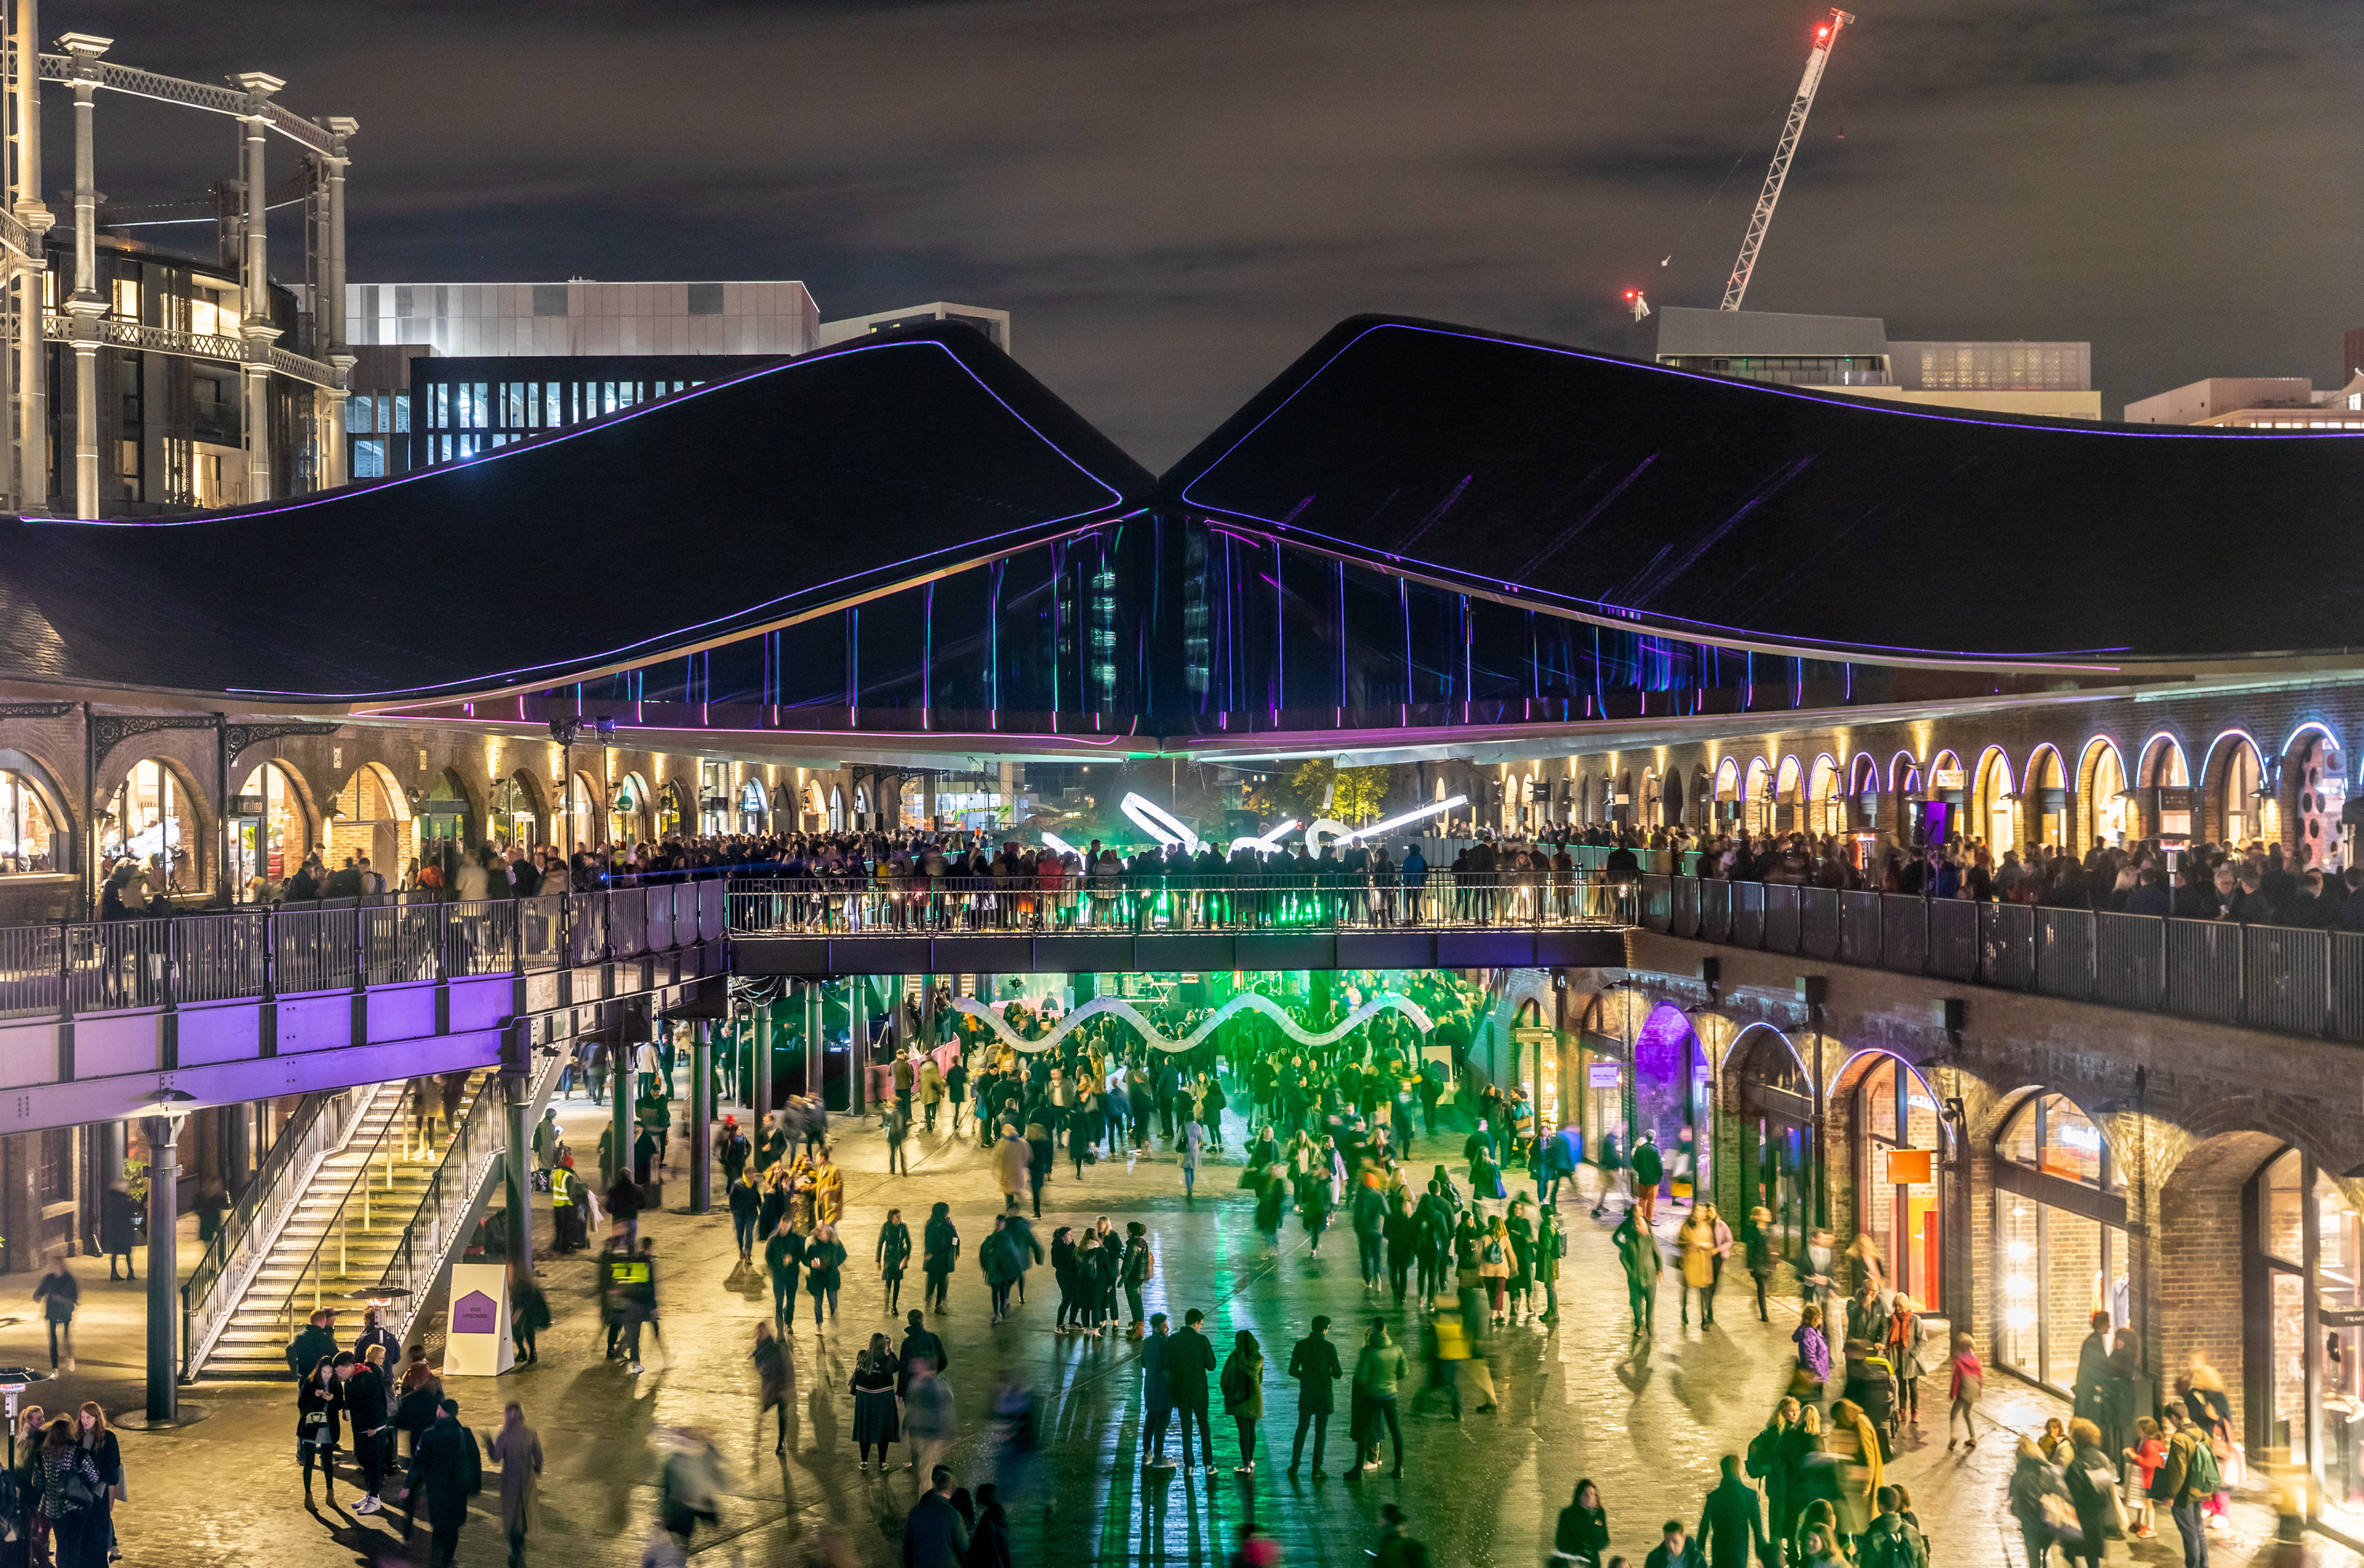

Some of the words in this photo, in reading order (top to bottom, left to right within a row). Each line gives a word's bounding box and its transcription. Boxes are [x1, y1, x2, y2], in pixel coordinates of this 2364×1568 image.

[335, 752, 341, 764] 04
[420, 755, 426, 765] 05
[238, 799, 262, 811] barrafina
